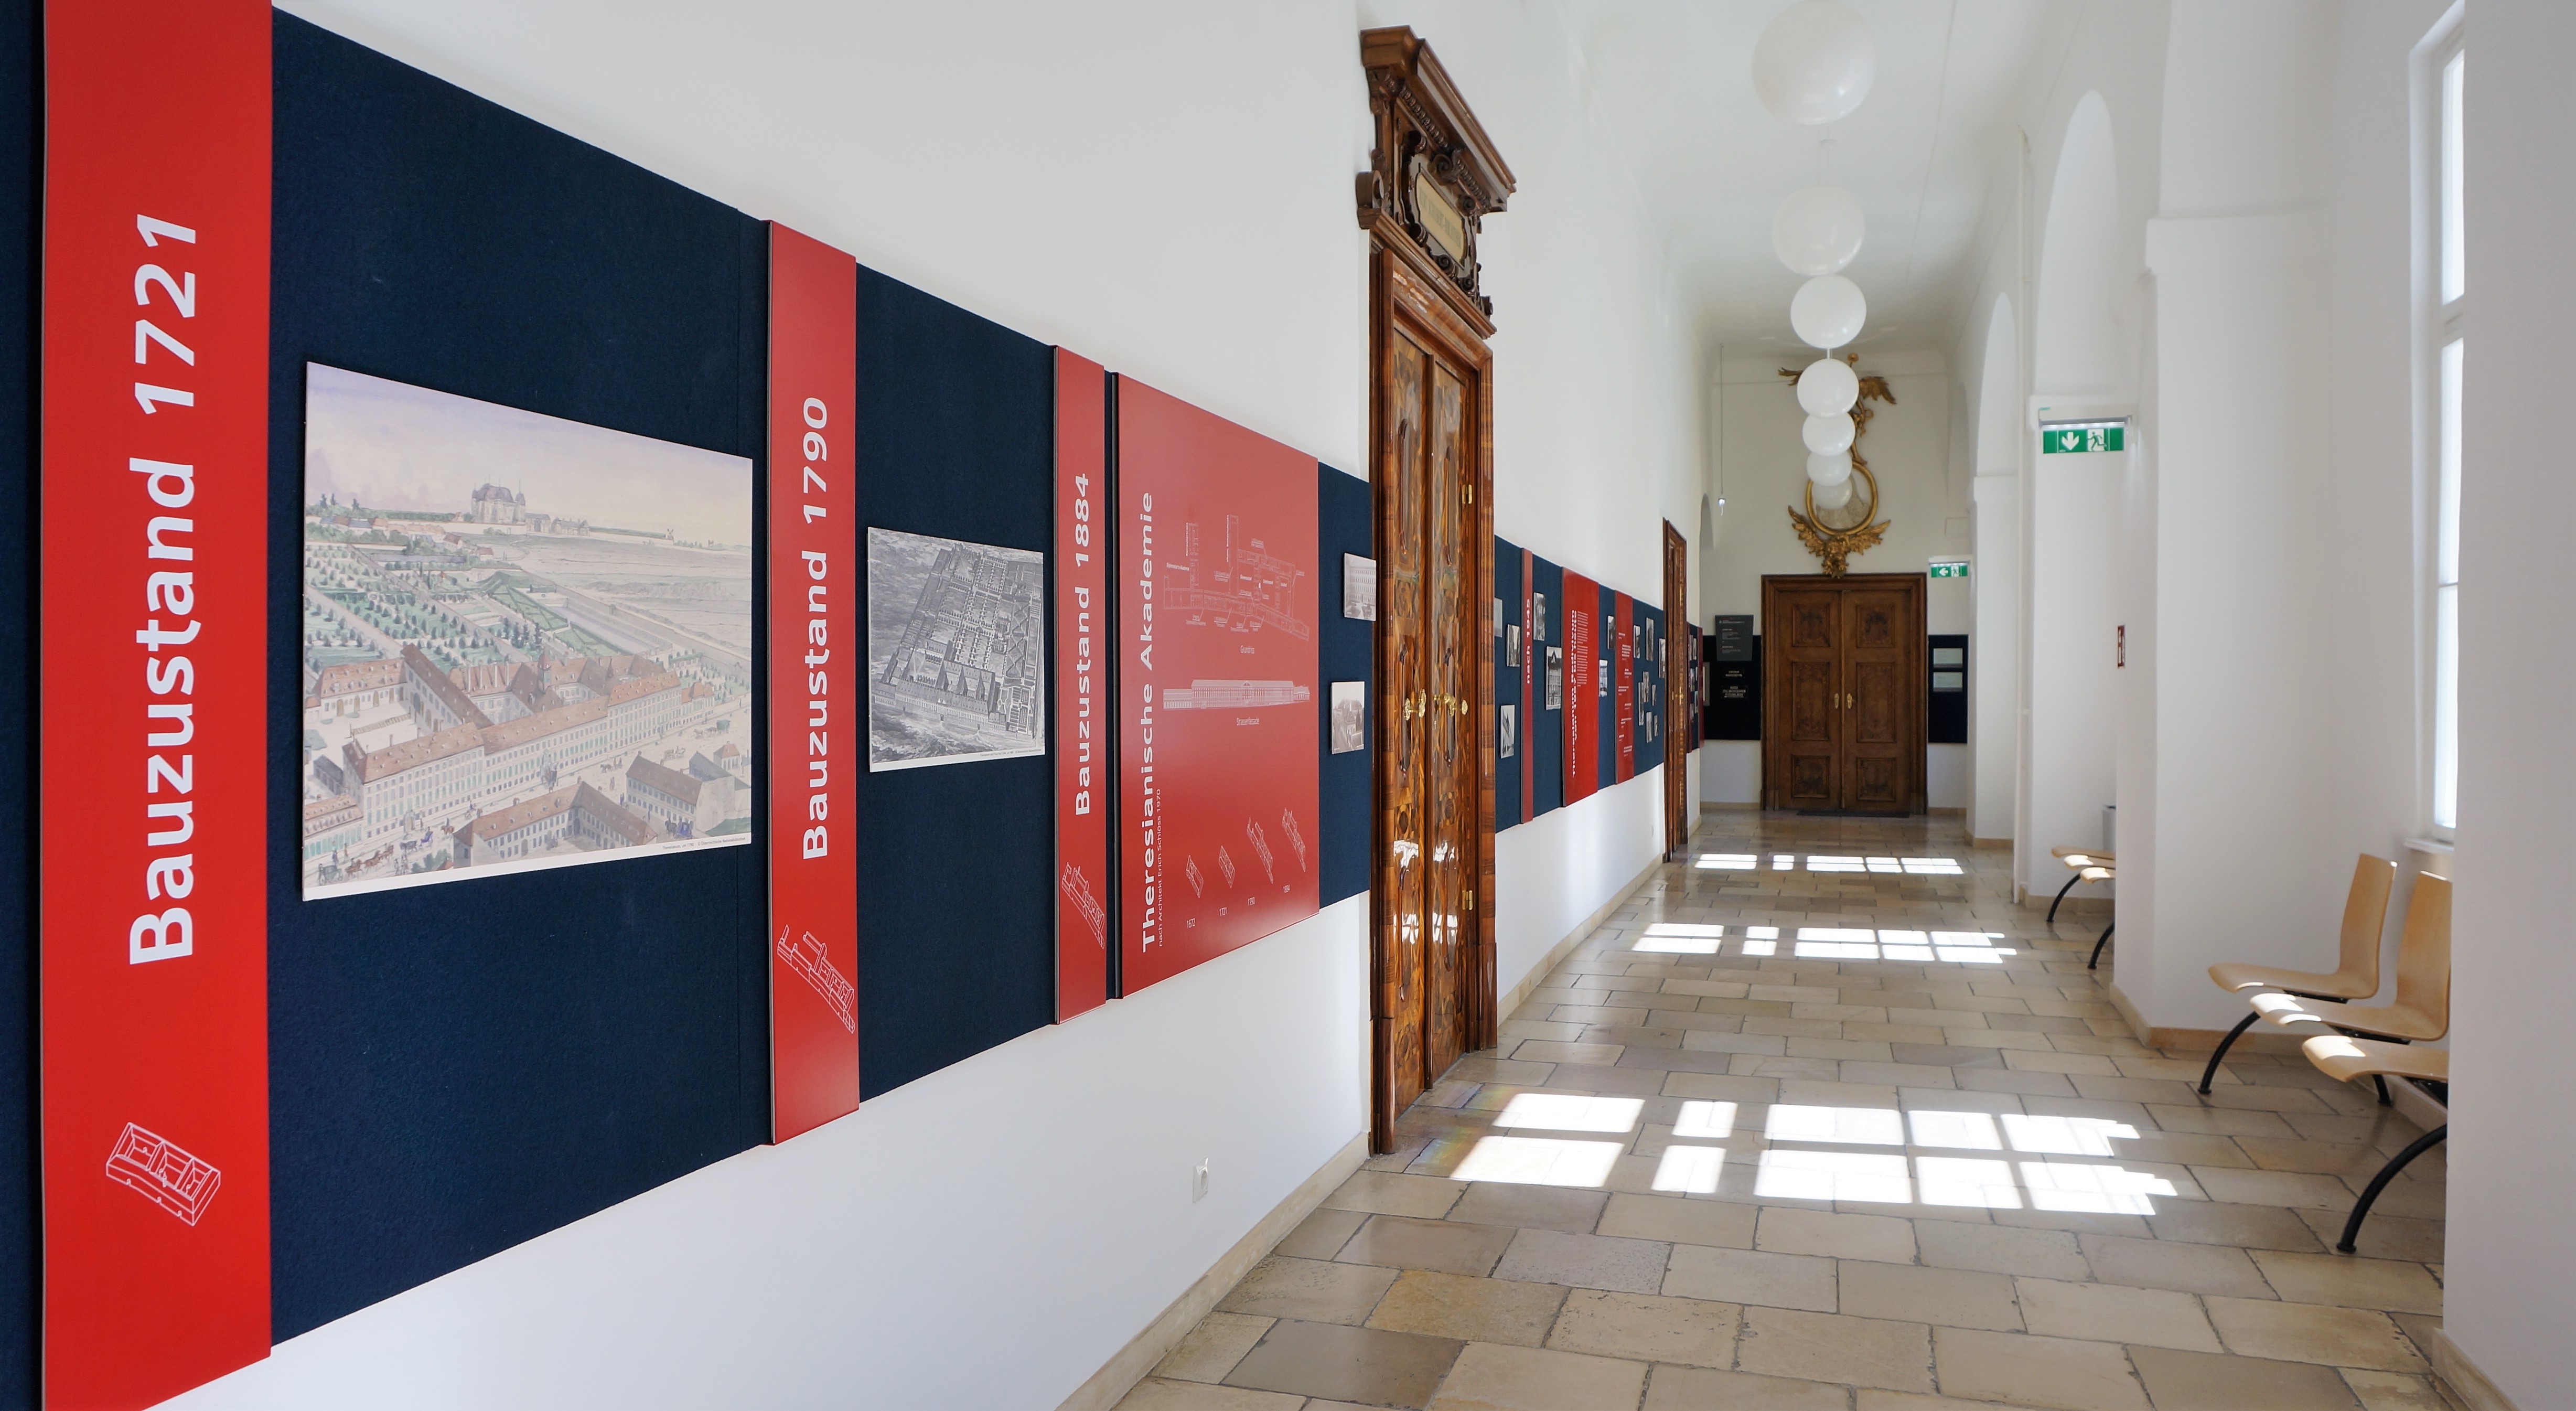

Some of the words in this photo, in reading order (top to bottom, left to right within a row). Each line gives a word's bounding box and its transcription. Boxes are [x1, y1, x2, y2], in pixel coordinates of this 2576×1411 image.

[135, 215, 197, 414] 1721
[803, 397, 827, 524] 1790
[1075, 473, 1089, 567] 1884
[1140, 493, 1153, 671] Akademie
[130, 458, 201, 964] Bauzustand
[802, 551, 830, 859] Bauzustand
[1075, 587, 1091, 815] Bauzustand
[1141, 683, 1155, 953] Theresianische
[1247, 896, 1255, 906] 1790
[1186, 918, 1196, 928] 1672
